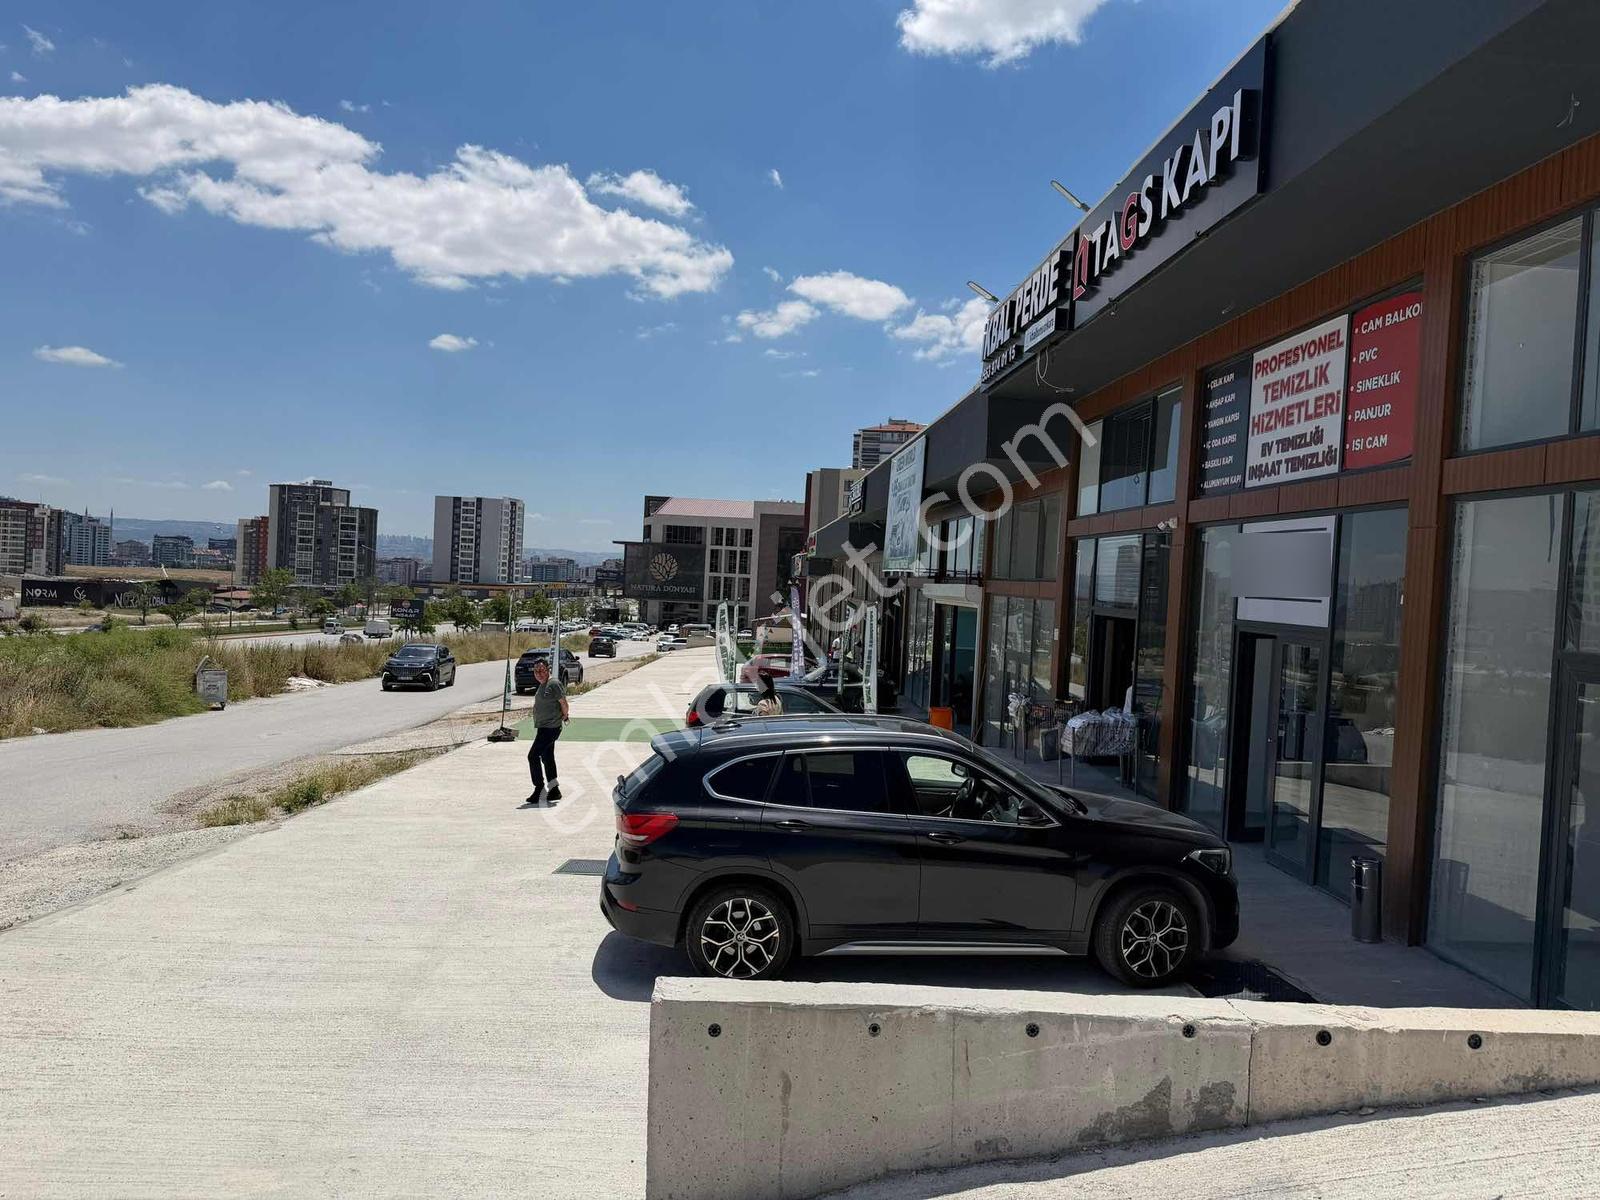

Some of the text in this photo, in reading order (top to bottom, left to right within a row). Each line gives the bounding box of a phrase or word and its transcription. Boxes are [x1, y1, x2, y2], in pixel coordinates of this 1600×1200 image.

[1161, 88, 1242, 220] KAPI
[1014, 249, 1061, 335] PERDE
[1361, 317, 1384, 334] CAM
[1255, 329, 1345, 380] PROFESYONEL
[1359, 347, 1379, 363] PVC
[1223, 372, 1235, 384] KAPI
[1224, 392, 1236, 404] KAPI
[1354, 404, 1392, 422] PANJUR
[1261, 440, 1274, 458] EV
[1352, 433, 1388, 451] ISI CAM
[631, 584, 661, 592] NATURA
